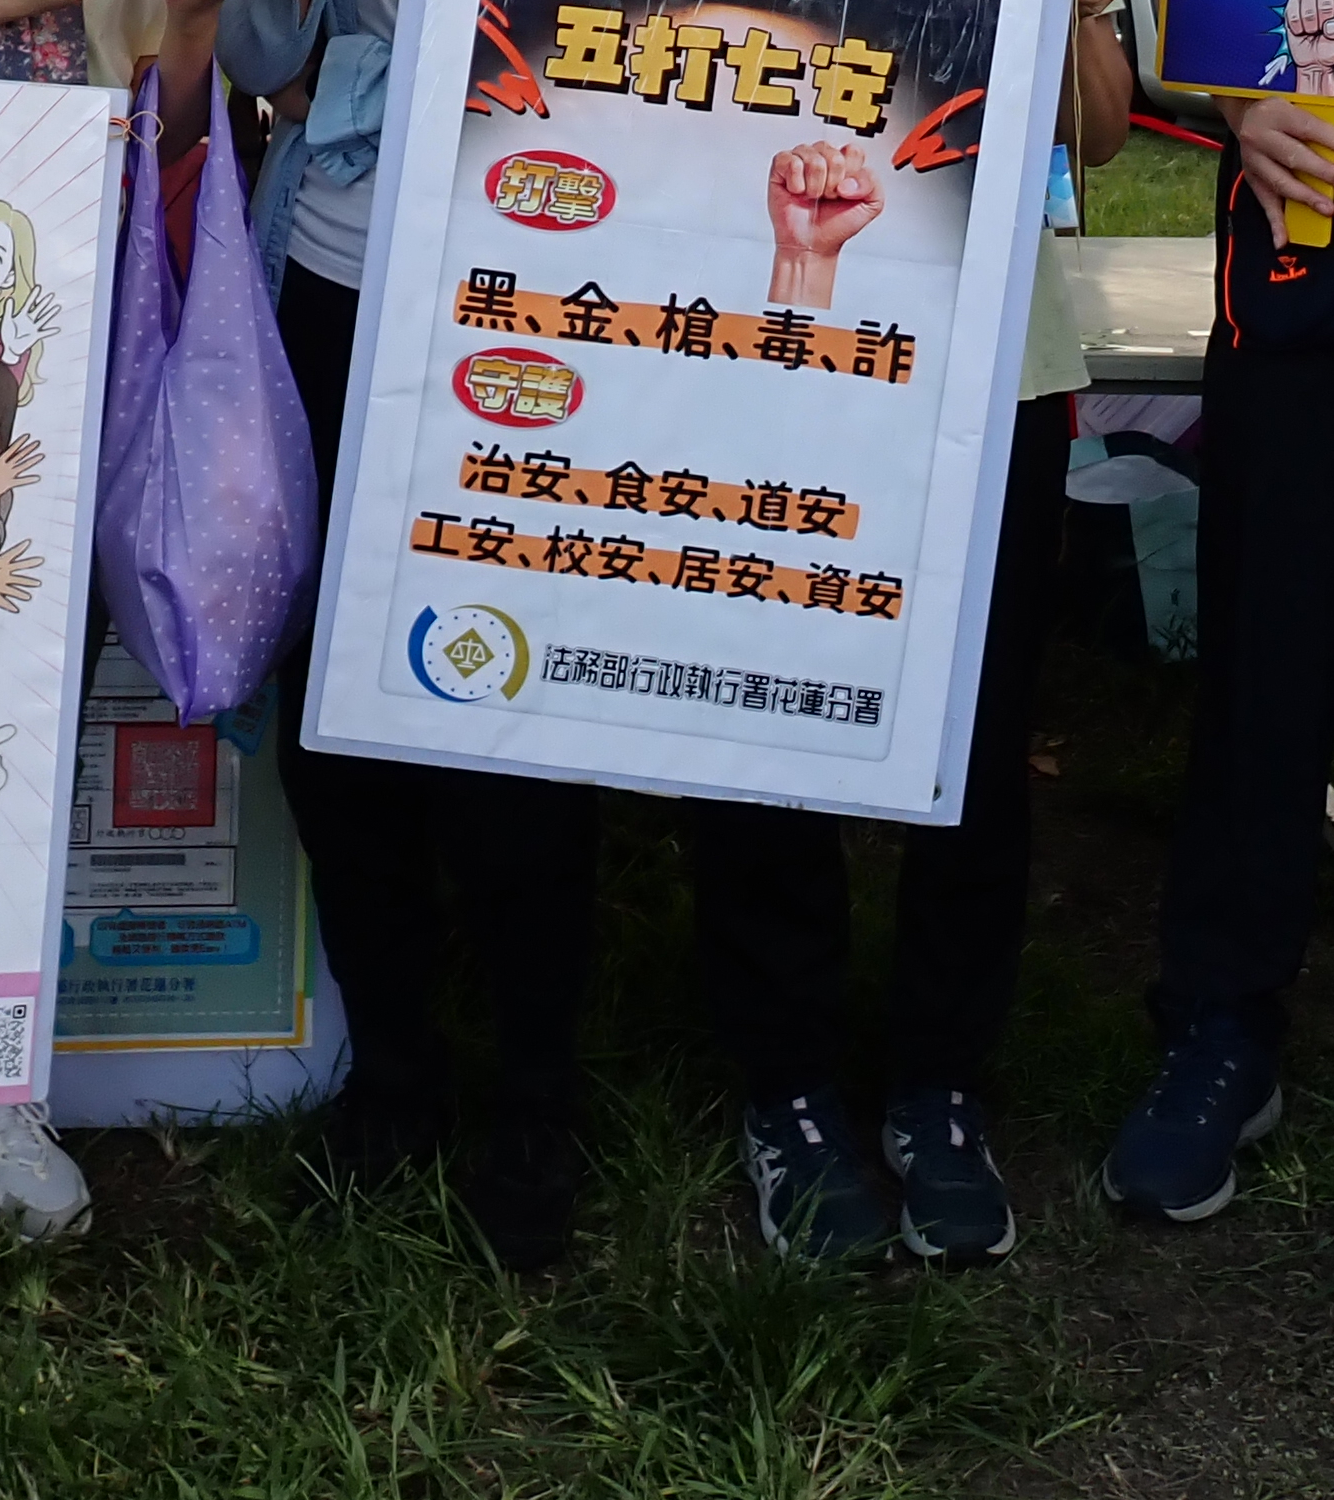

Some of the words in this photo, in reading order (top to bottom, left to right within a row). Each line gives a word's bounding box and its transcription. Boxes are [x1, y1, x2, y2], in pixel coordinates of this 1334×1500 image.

[544, 3, 901, 139] 五打七安
[496, 159, 603, 225] 打擊
[457, 266, 916, 386] 黑、金、槍、毒、詐
[466, 358, 577, 422] 守護
[464, 439, 849, 540] 治安、食安、道安
[410, 509, 904, 621] 工安、校安、居安、資安
[540, 642, 886, 729] 法務部行政執行署花蓮分署
